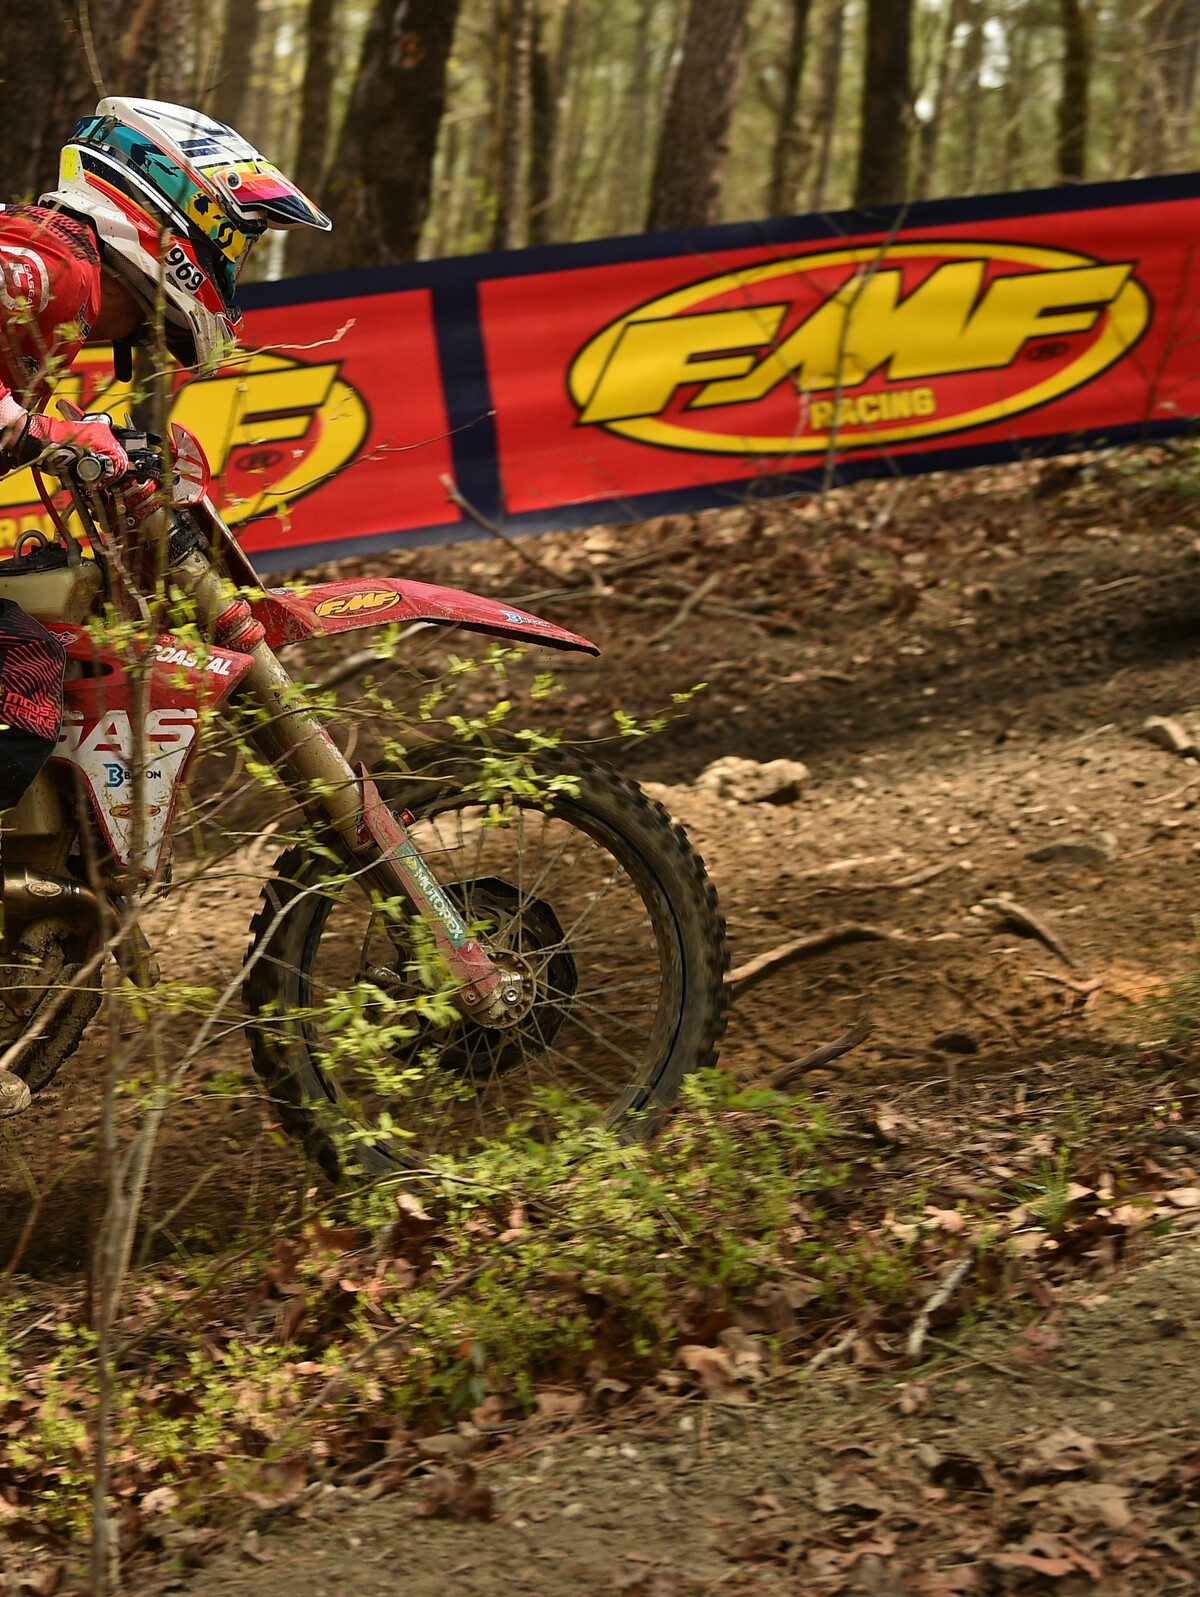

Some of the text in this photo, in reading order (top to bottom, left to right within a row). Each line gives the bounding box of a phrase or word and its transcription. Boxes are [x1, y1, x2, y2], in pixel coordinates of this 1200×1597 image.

[23, 263, 36, 309] GASGA
[165, 247, 204, 291] 969
[574, 257, 1139, 427] FMF
[808, 385, 936, 430] RACING
[317, 591, 398, 616] FMF
[3, 702, 56, 730] RACING
